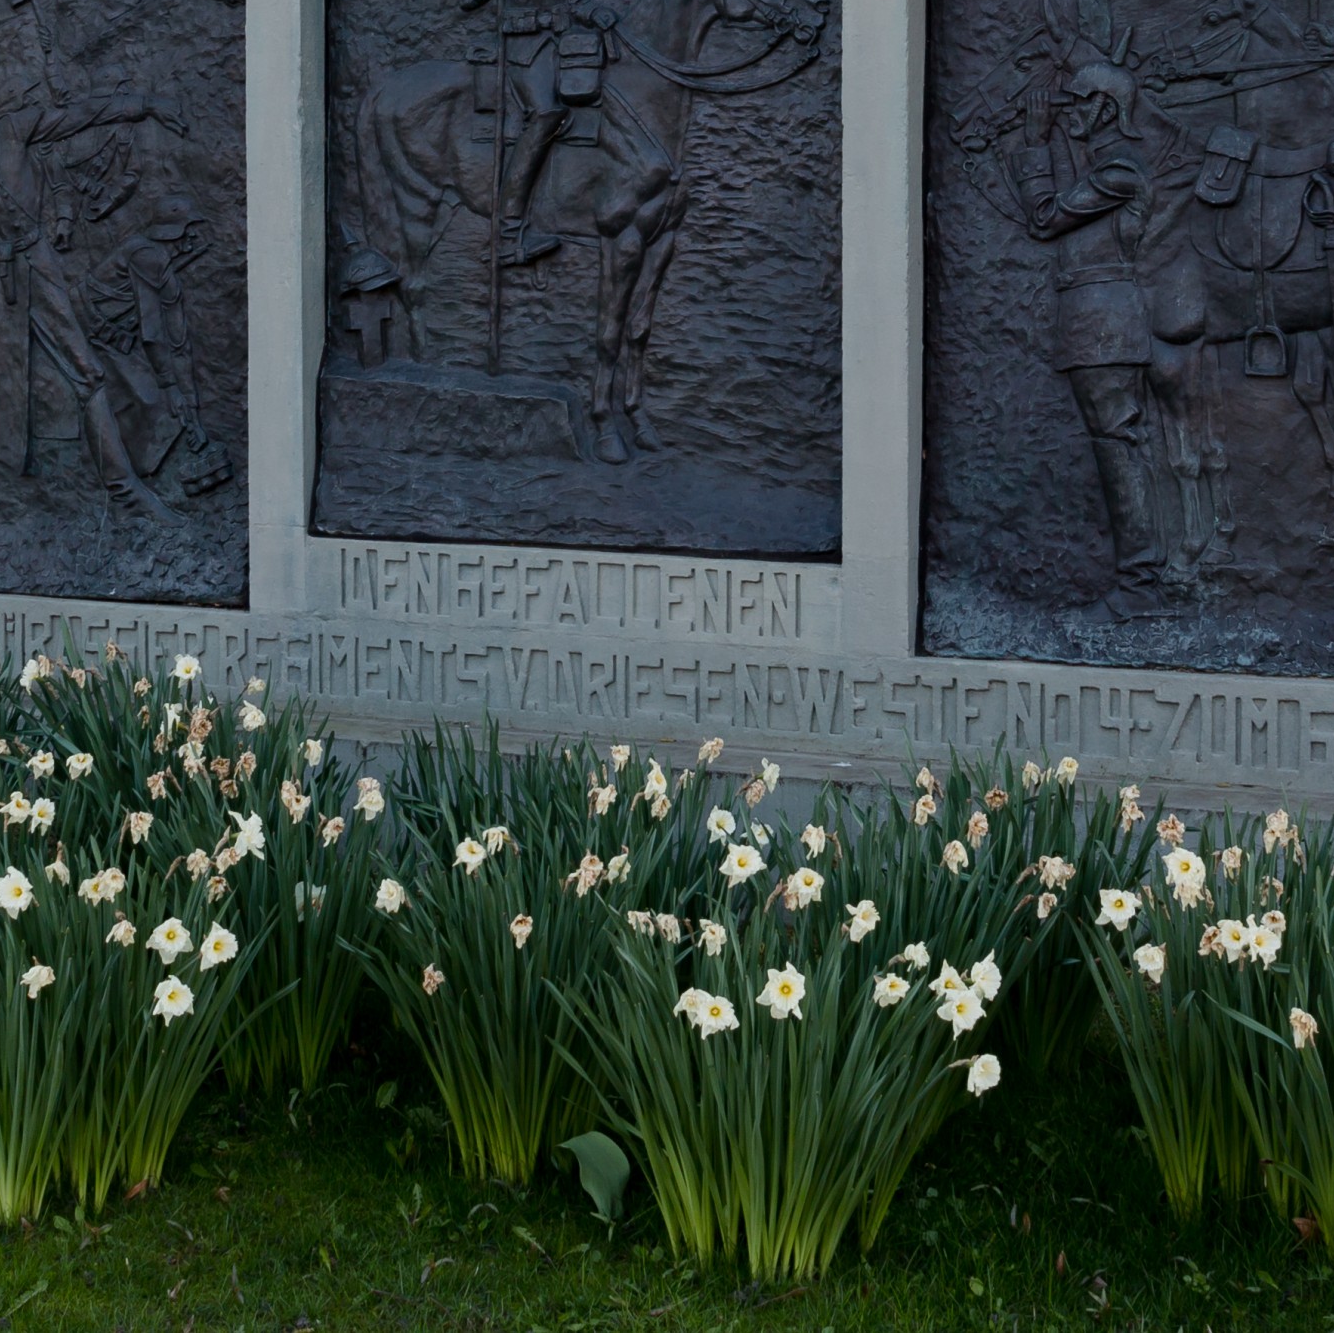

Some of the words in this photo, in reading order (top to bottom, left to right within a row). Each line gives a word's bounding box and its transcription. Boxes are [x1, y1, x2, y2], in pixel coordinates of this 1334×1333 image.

[343, 548, 439, 615] DEN
[450, 554, 799, 639] GEFALLENEN
[218, 627, 488, 705] REGIMENTS
